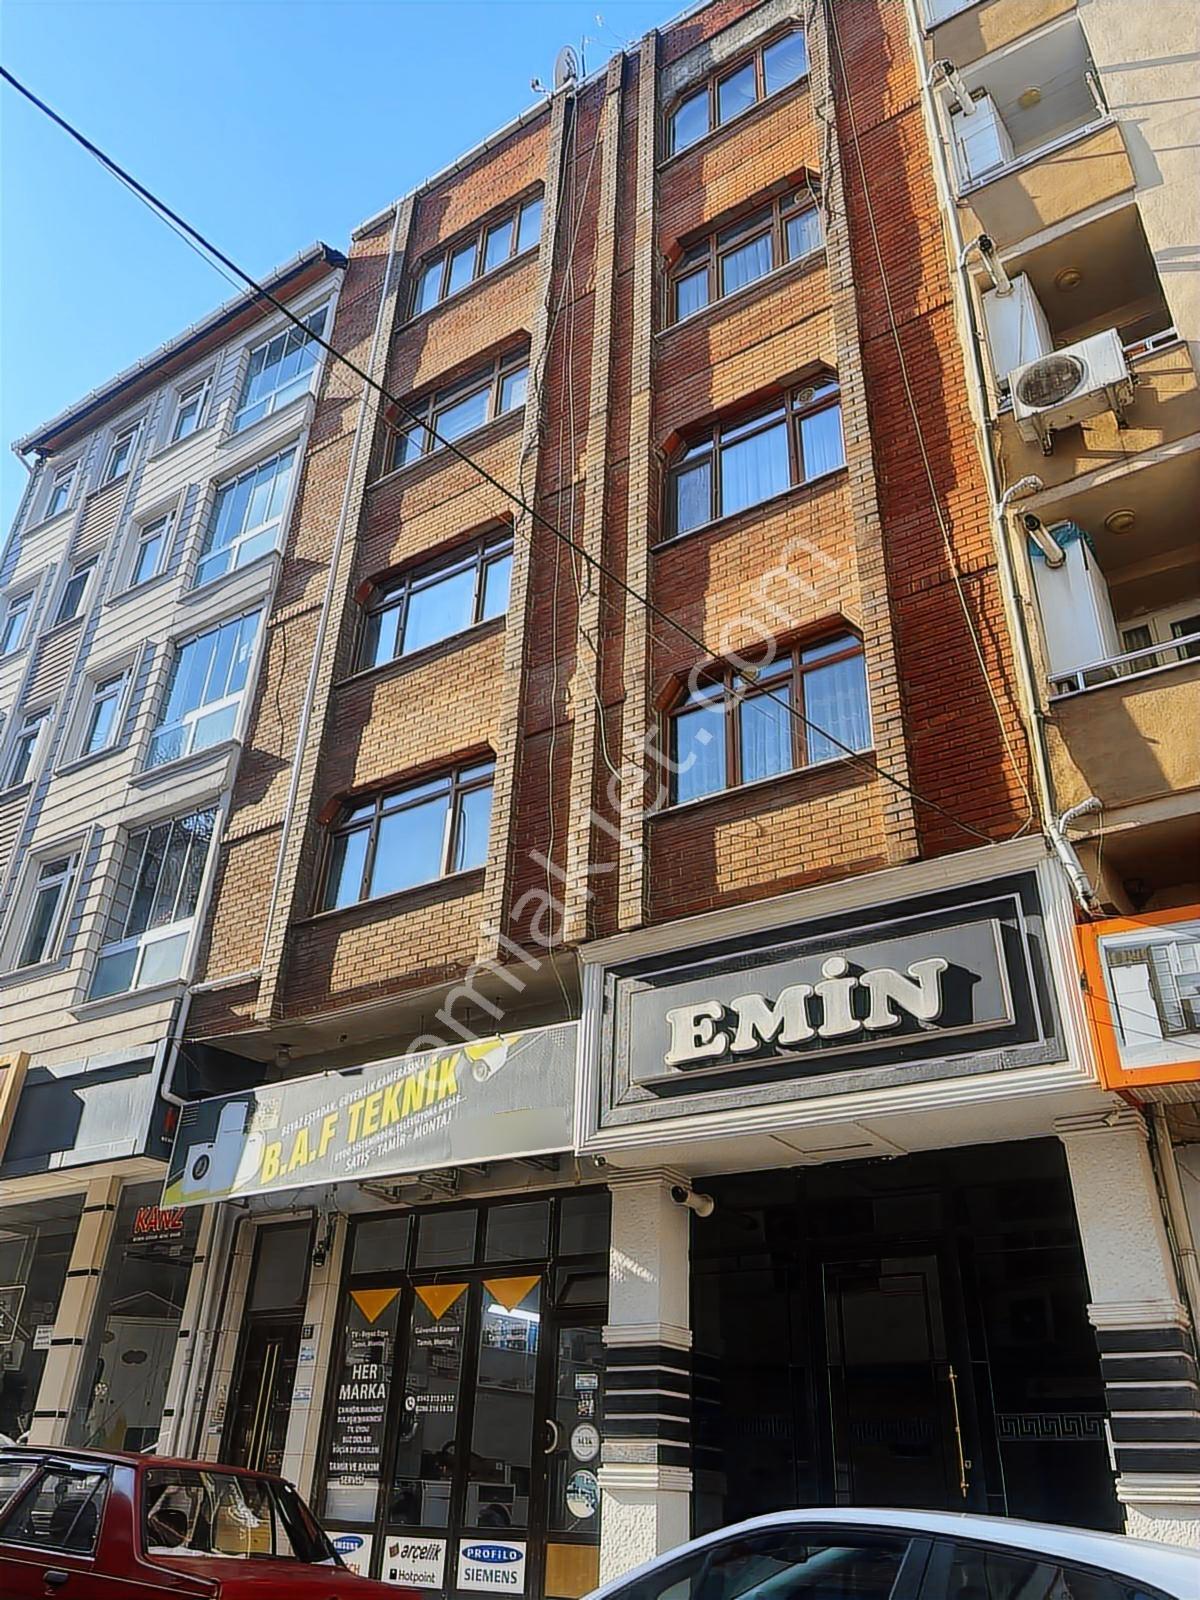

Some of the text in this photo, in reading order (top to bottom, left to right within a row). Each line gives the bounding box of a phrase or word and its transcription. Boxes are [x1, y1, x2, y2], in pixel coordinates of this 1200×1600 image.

[260, 1050, 461, 1185] B.A.F TEKNİK
[352, 1364, 378, 1380] HER
[338, 1383, 386, 1401] MARKA
[400, 1543, 442, 1563] arçelik
[398, 1570, 436, 1584] Hotpoint
[464, 1567, 518, 1584] SIEMENS
